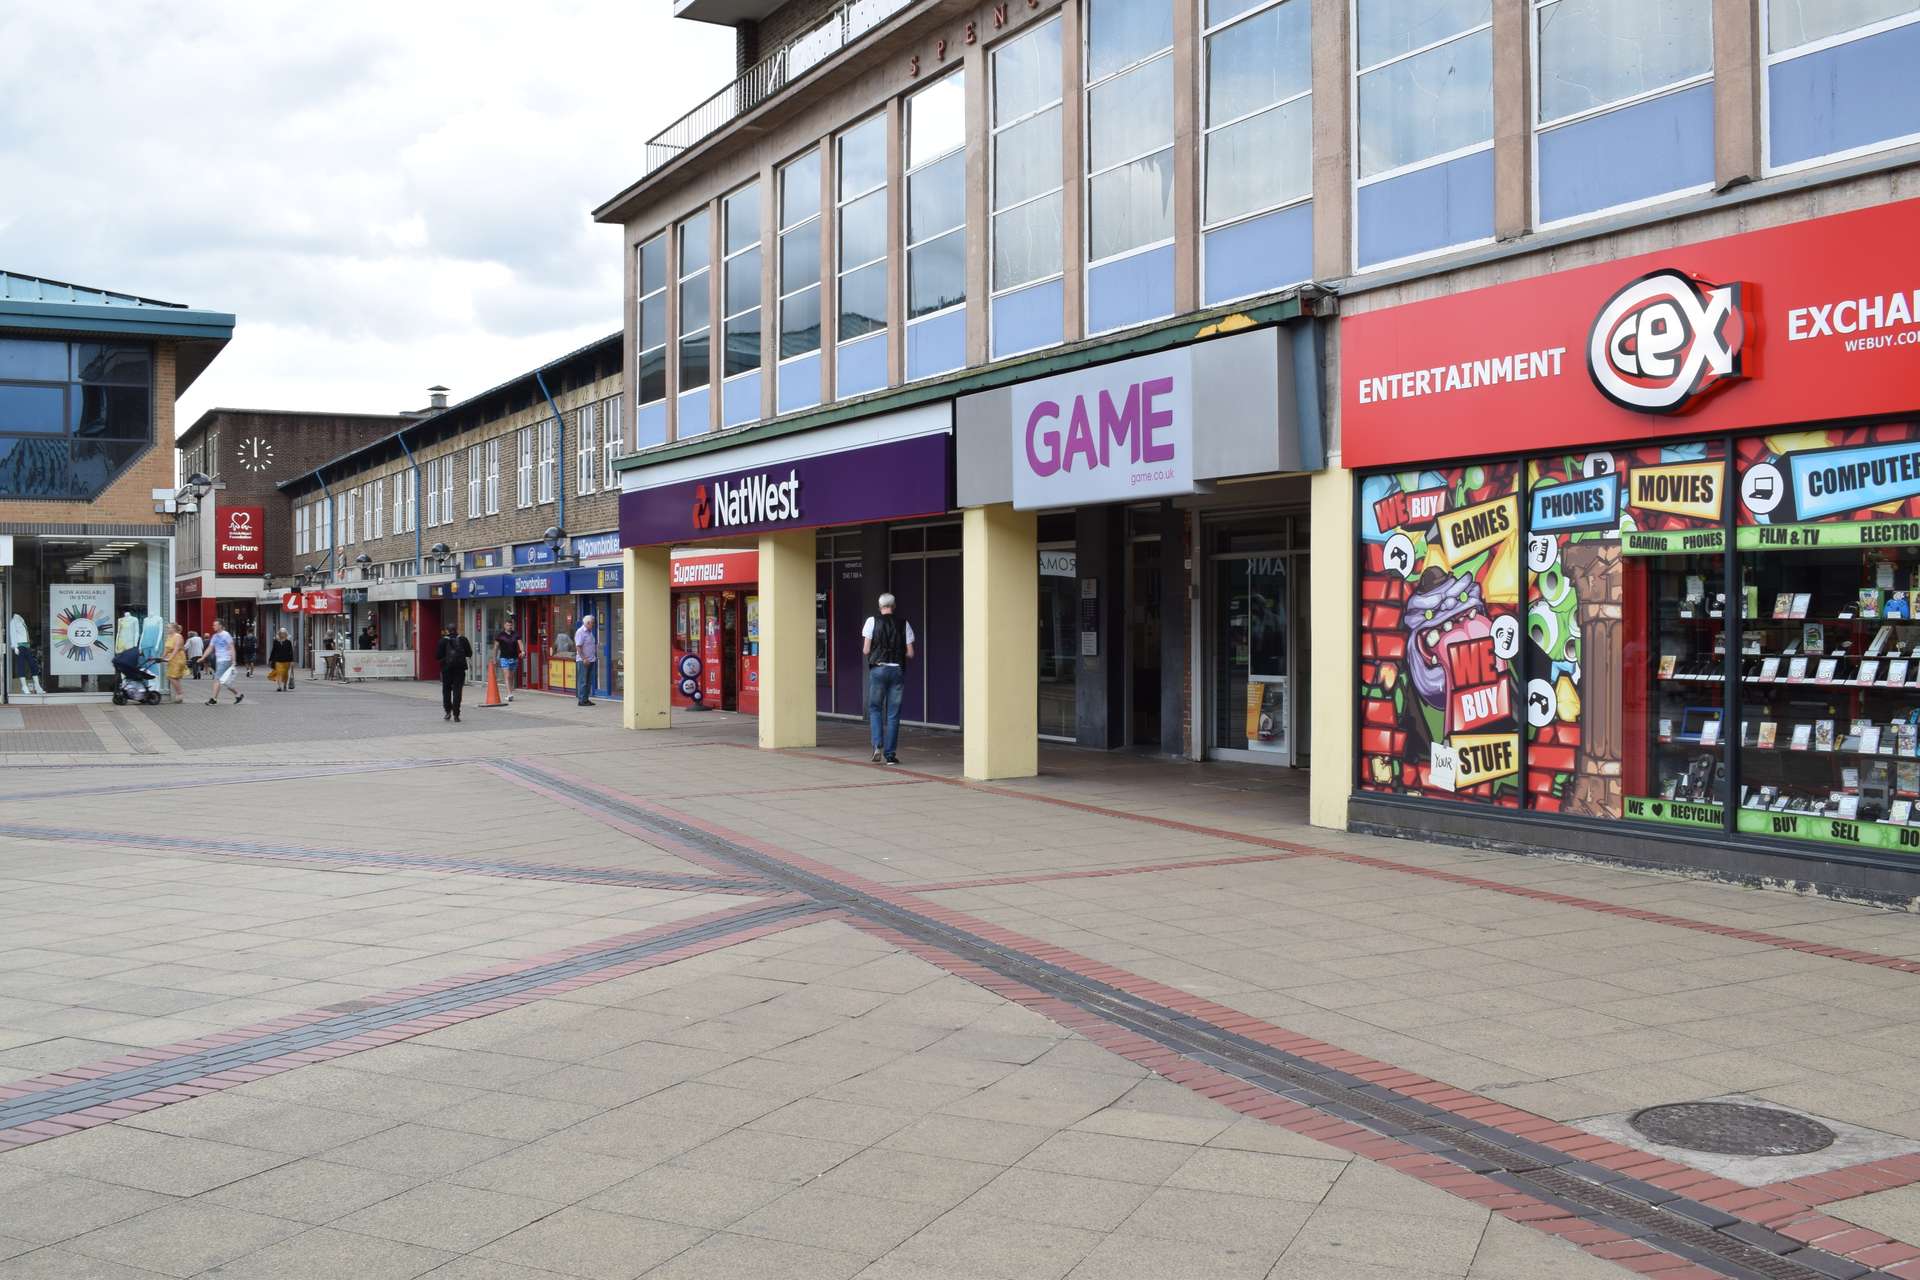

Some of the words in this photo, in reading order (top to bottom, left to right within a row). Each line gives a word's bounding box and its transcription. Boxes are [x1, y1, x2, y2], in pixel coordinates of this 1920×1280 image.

[1359, 347, 1566, 404] ENTERTAINMENT
[1025, 376, 1175, 478] GAME
[1130, 468, 1175, 486] game.co.uk
[1638, 474, 1714, 503] MOVIES
[715, 469, 799, 527] NatWest
[1541, 488, 1604, 519] PHONES
[1377, 492, 1409, 532] WE
[1411, 495, 1439, 518] BUY
[1451, 504, 1510, 548] GAMES
[1759, 528, 1787, 544] FILM
[1791, 531, 1801, 545] &
[1802, 529, 1820, 545] TV
[222, 544, 258, 552] Furniture
[1629, 535, 1668, 551] GAMING
[1683, 532, 1723, 549] PHONES
[673, 562, 724, 583] Supernews
[1450, 638, 1498, 687] WE
[1461, 687, 1499, 722] BUY
[1434, 754, 1453, 770] YOUR
[1459, 741, 1513, 775] STUFF
[1629, 800, 1644, 815] WE
[1773, 816, 1798, 832] BUY
[1831, 821, 1860, 842] SELL
